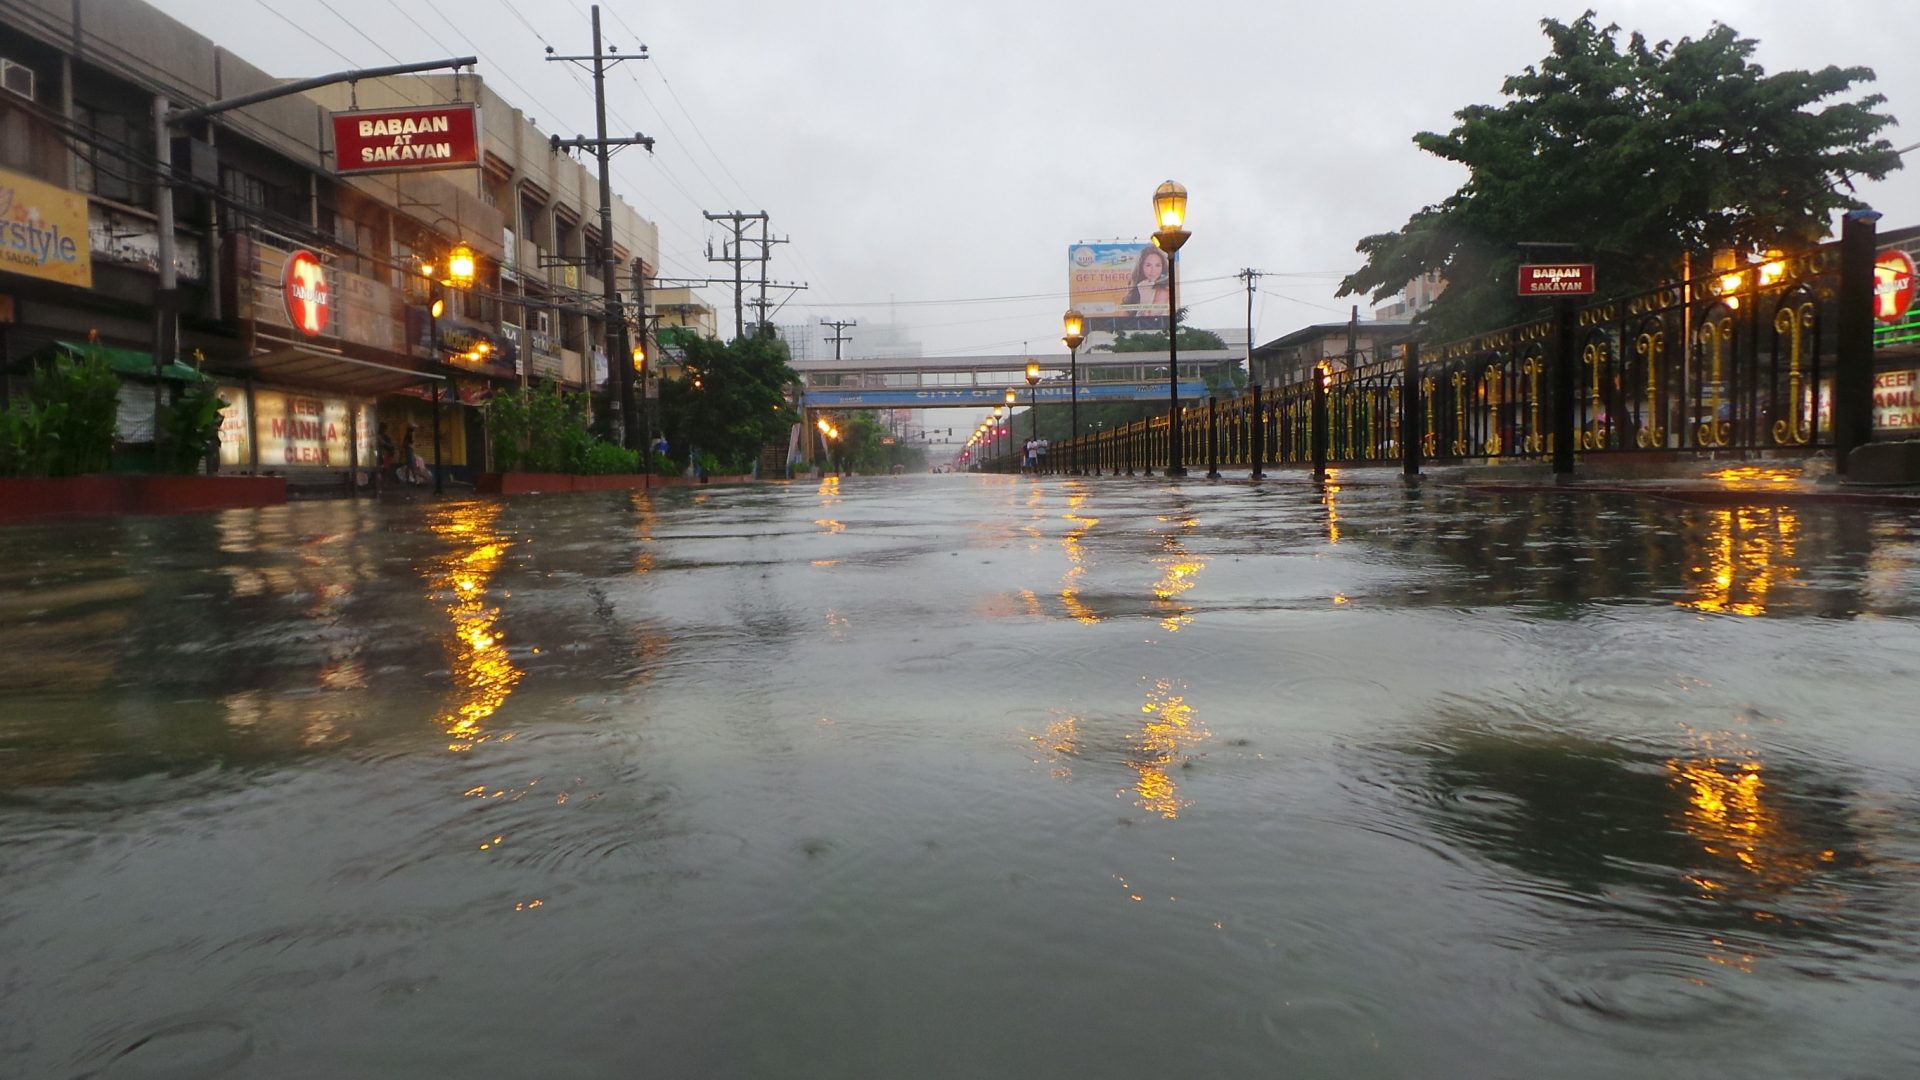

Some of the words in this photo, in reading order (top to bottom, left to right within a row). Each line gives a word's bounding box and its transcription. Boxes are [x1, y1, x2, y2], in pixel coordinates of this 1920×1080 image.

[359, 116, 449, 137] BABAAN
[394, 135, 412, 145] AT
[361, 143, 451, 162] SAKAYAN
[6, 251, 39, 267] SALON
[1076, 273, 1096, 282] GET
[1533, 269, 1580, 278] BABAAN
[1530, 282, 1582, 291] SAKAYAN
[1873, 372, 1917, 388] KEEP
[286, 399, 324, 415] KEEP
[271, 418, 337, 441] MANILA
[284, 446, 329, 464] CLEAN
